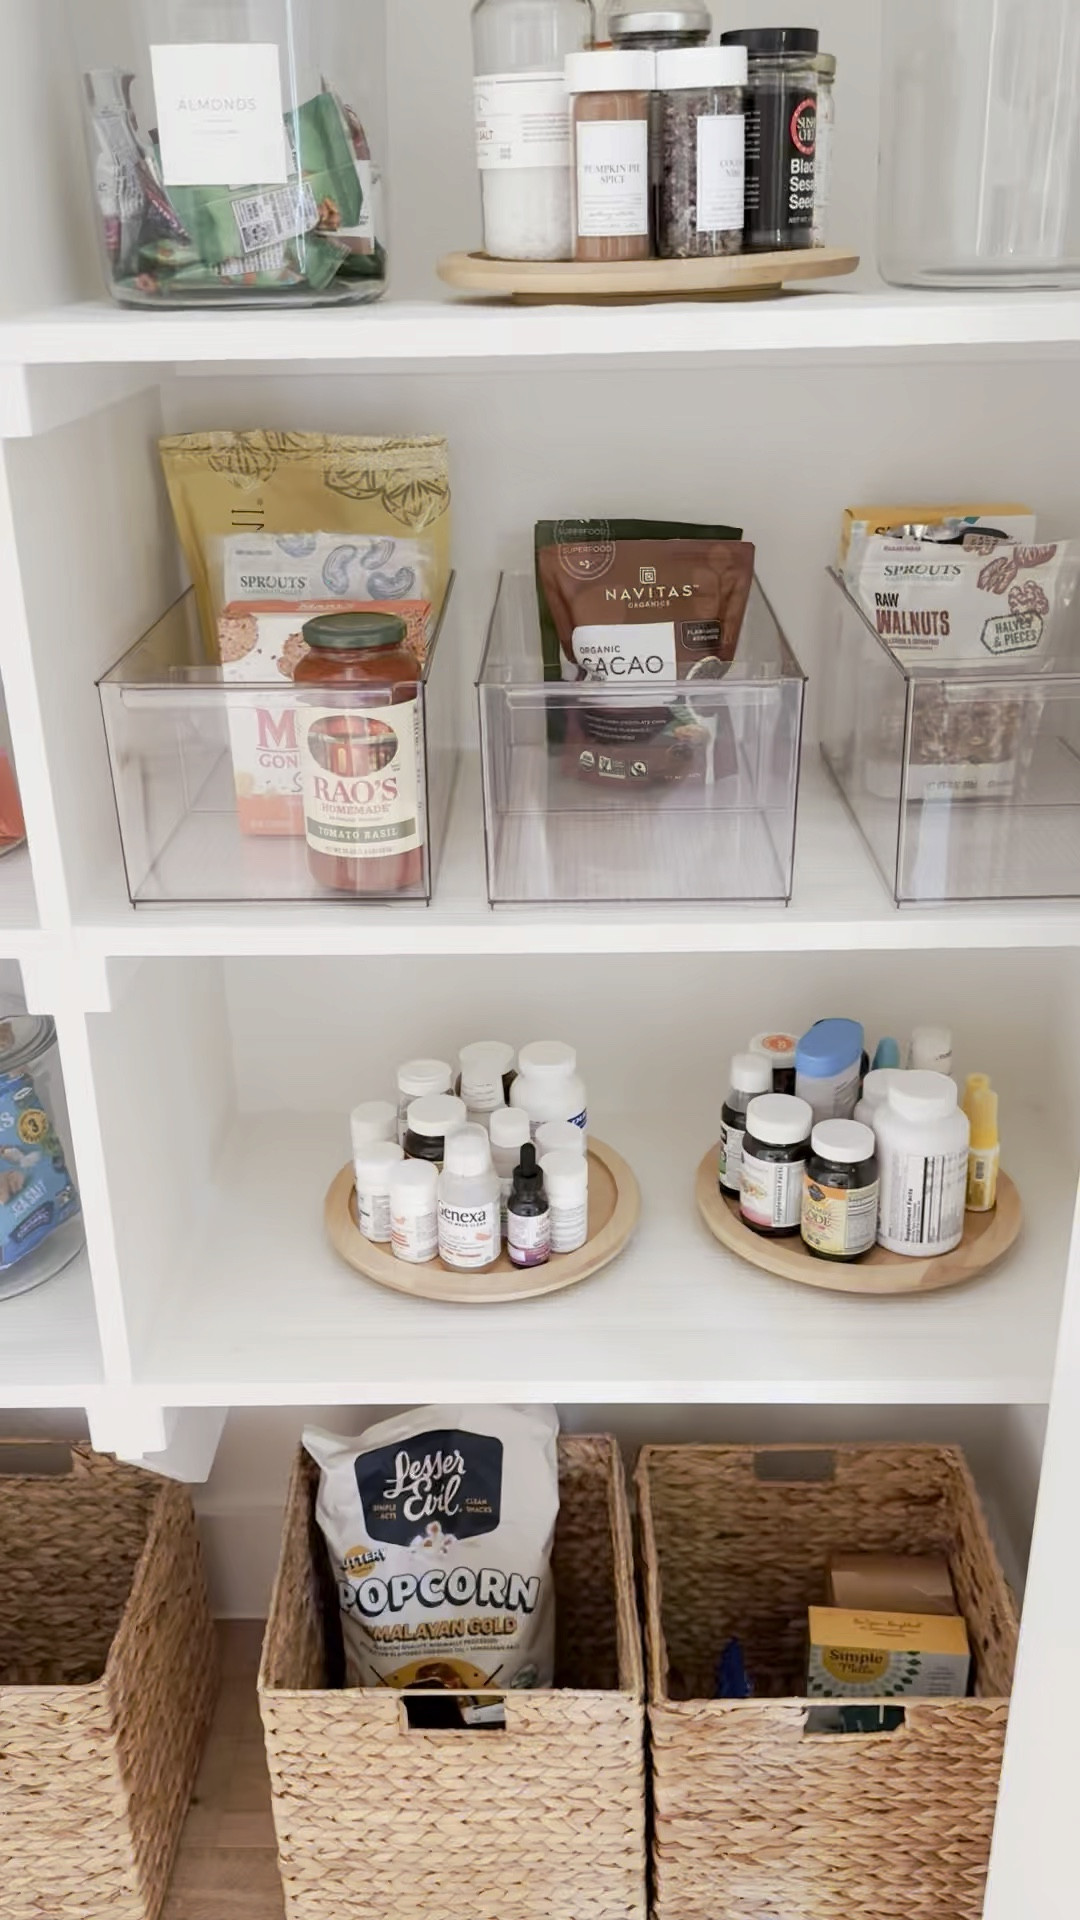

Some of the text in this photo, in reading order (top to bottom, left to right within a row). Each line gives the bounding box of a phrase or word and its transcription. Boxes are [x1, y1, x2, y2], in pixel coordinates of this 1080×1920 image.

[176, 98, 257, 111] ALMONDS
[584, 164, 626, 173] PUMPKIN
[561, 544, 613, 554] SUPERFOOD
[883, 564, 962, 577] SPROUTS
[240, 575, 307, 589] SPROUTS
[605, 584, 693, 601] NAVITAS
[875, 592, 899, 608] RAW
[628, 600, 670, 608] ORGANICS
[875, 610, 950, 636] WALNUTS
[995, 619, 1031, 635] HALVES
[1004, 629, 1038, 646] PIECES
[580, 645, 621, 654] ORGANIC
[259, 753, 298, 769] GON
[313, 776, 398, 804] RAO'S
[322, 803, 391, 815] HOMEMADE
[319, 826, 400, 840] TOMATO BASIL
[441, 1208, 487, 1224] enexa
[383, 1450, 467, 1499] Lesser
[341, 1550, 386, 1570] UTTERY
[340, 1567, 540, 1617] POPCORN
[468, 1617, 517, 1637] GOLD
[829, 1649, 883, 1665] Simple
